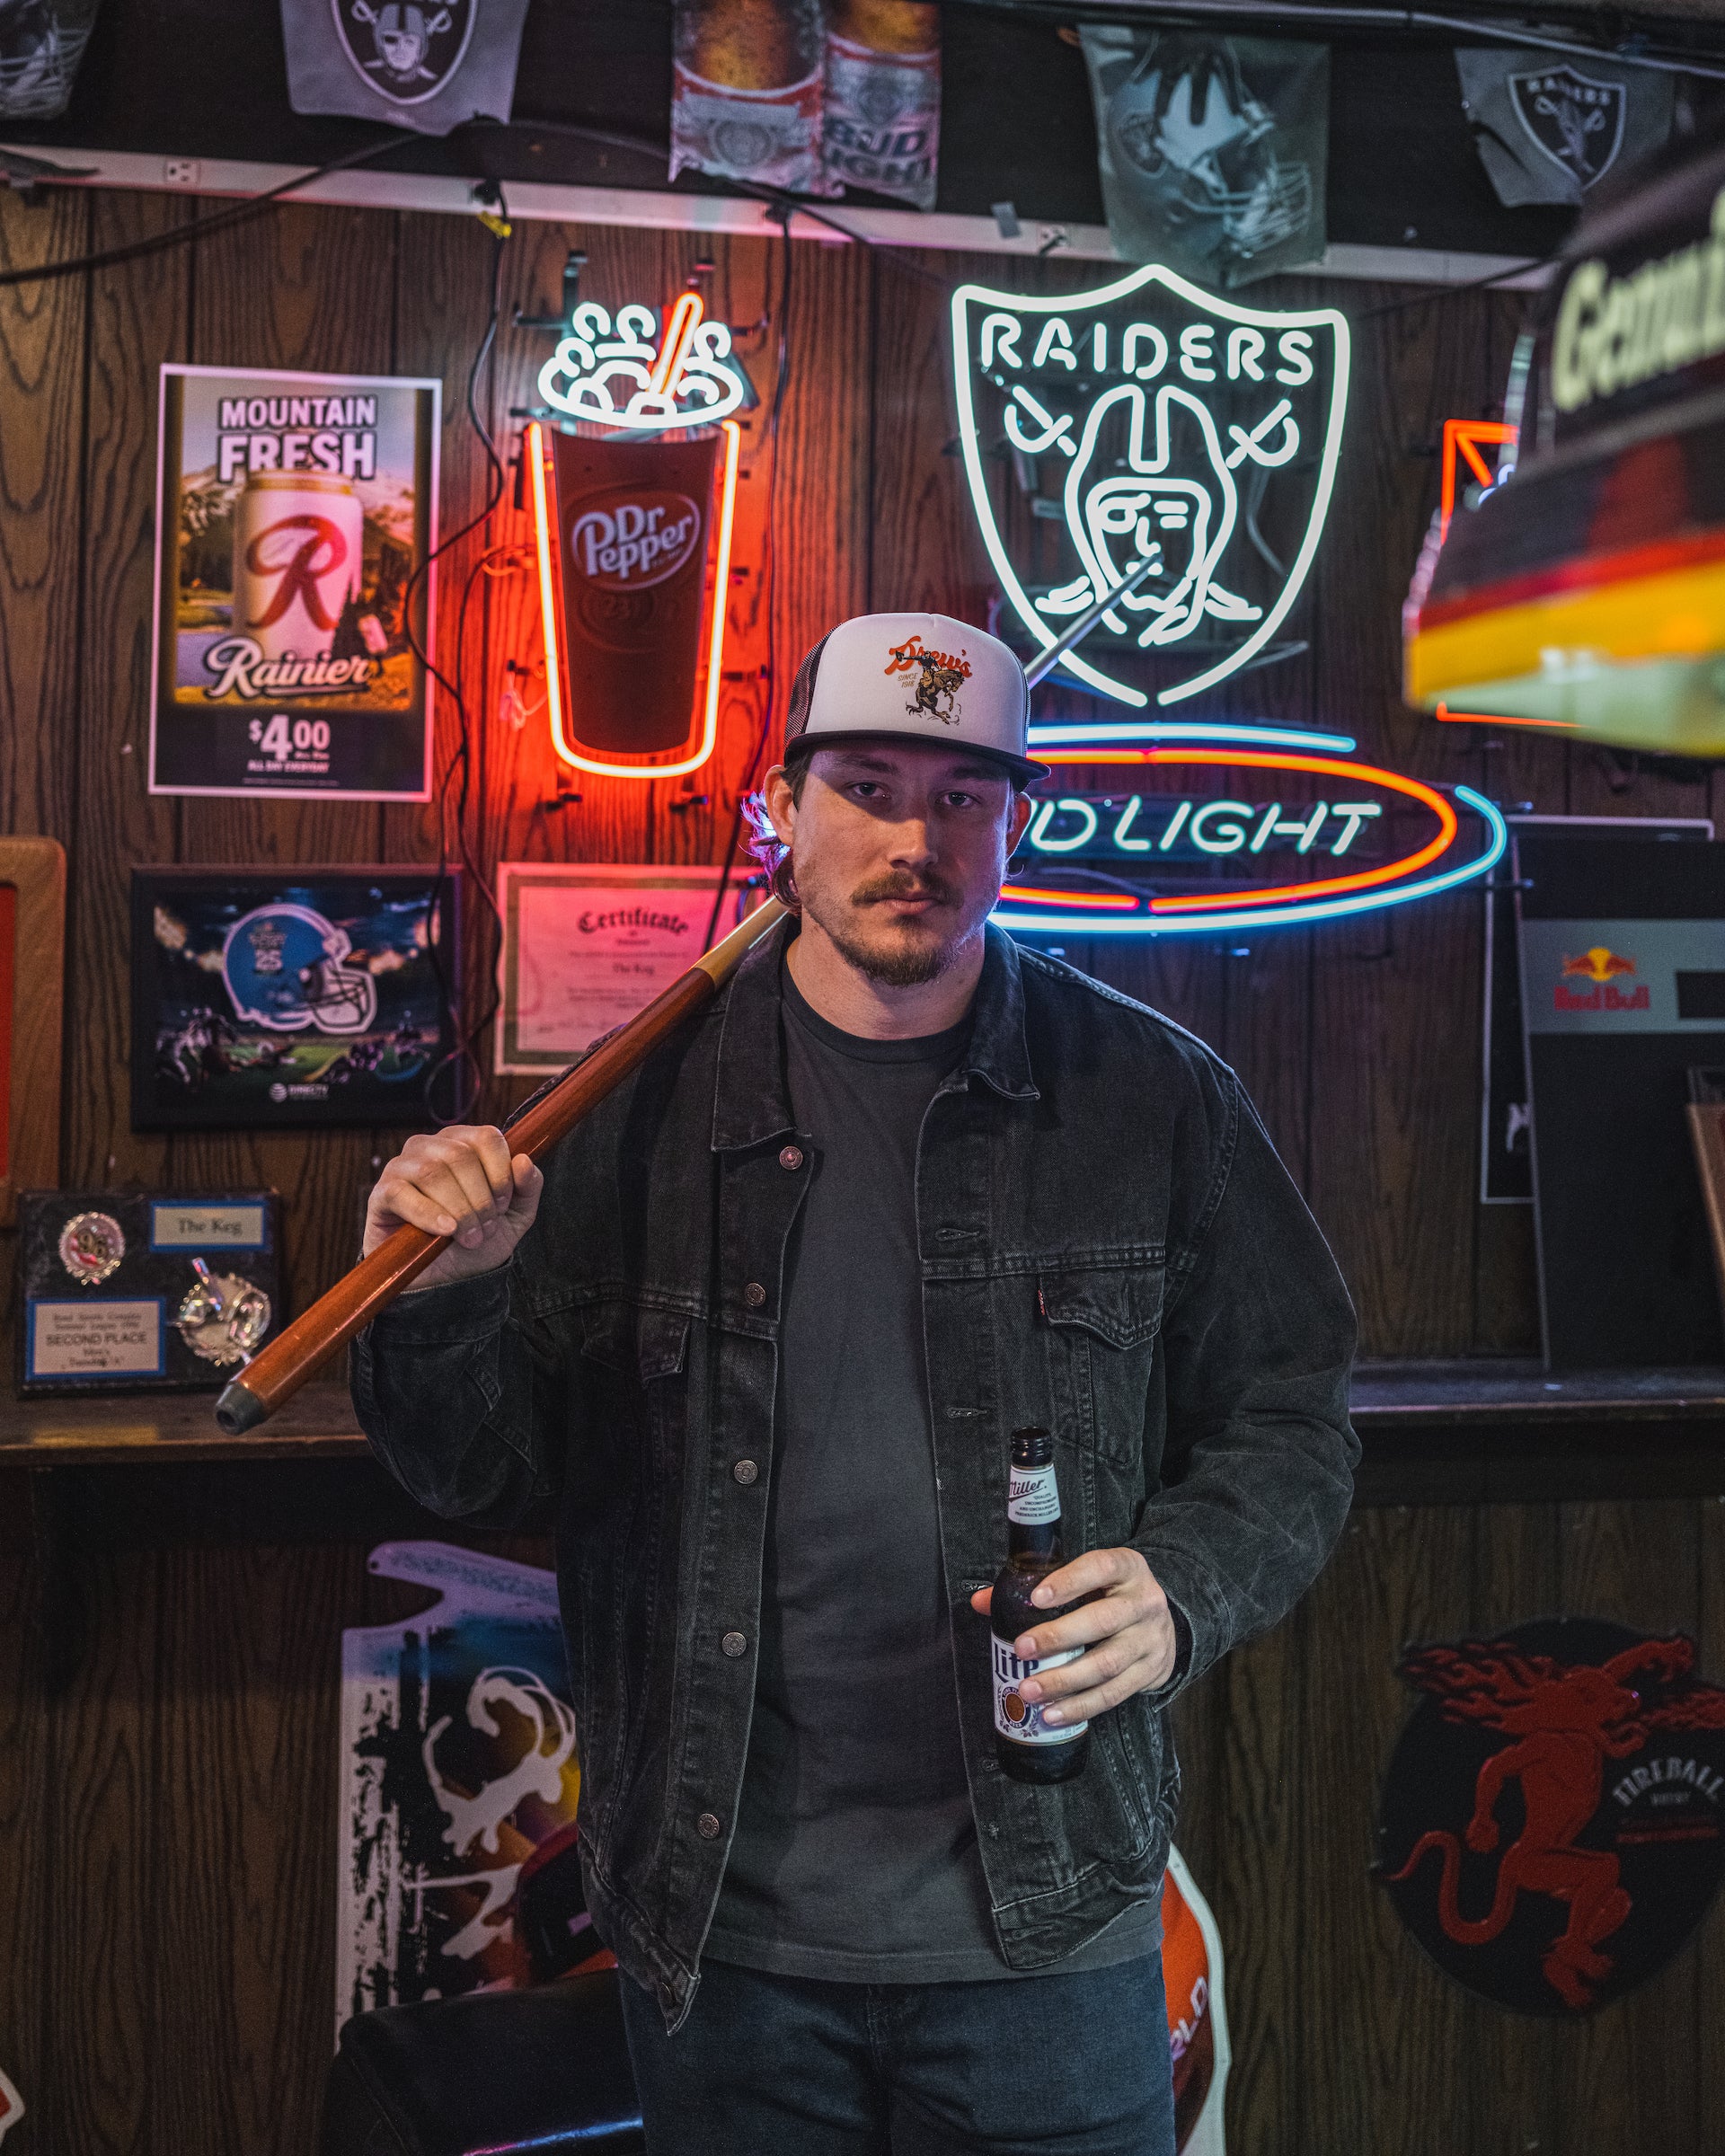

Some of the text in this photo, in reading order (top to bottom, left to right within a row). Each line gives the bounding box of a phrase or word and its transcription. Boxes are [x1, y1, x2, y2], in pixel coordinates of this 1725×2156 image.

[1528, 77, 1611, 107] RAERS
[980, 313, 1314, 386] RAIDERS
[220, 395, 376, 429] MOUNTAIN
[218, 431, 376, 482] FRESH
[615, 505, 665, 543] Dr
[574, 511, 693, 579] Pepper
[247, 514, 348, 632] R
[206, 636, 371, 698] Rainier
[898, 673, 918, 682] SINCE
[1030, 795, 1382, 856] D LIGHT
[577, 906, 689, 935] Certificate
[179, 1217, 243, 1237] The Keg
[46, 1331, 146, 1347] SECOND PLACE
[1010, 1479, 1046, 1496] Miller
